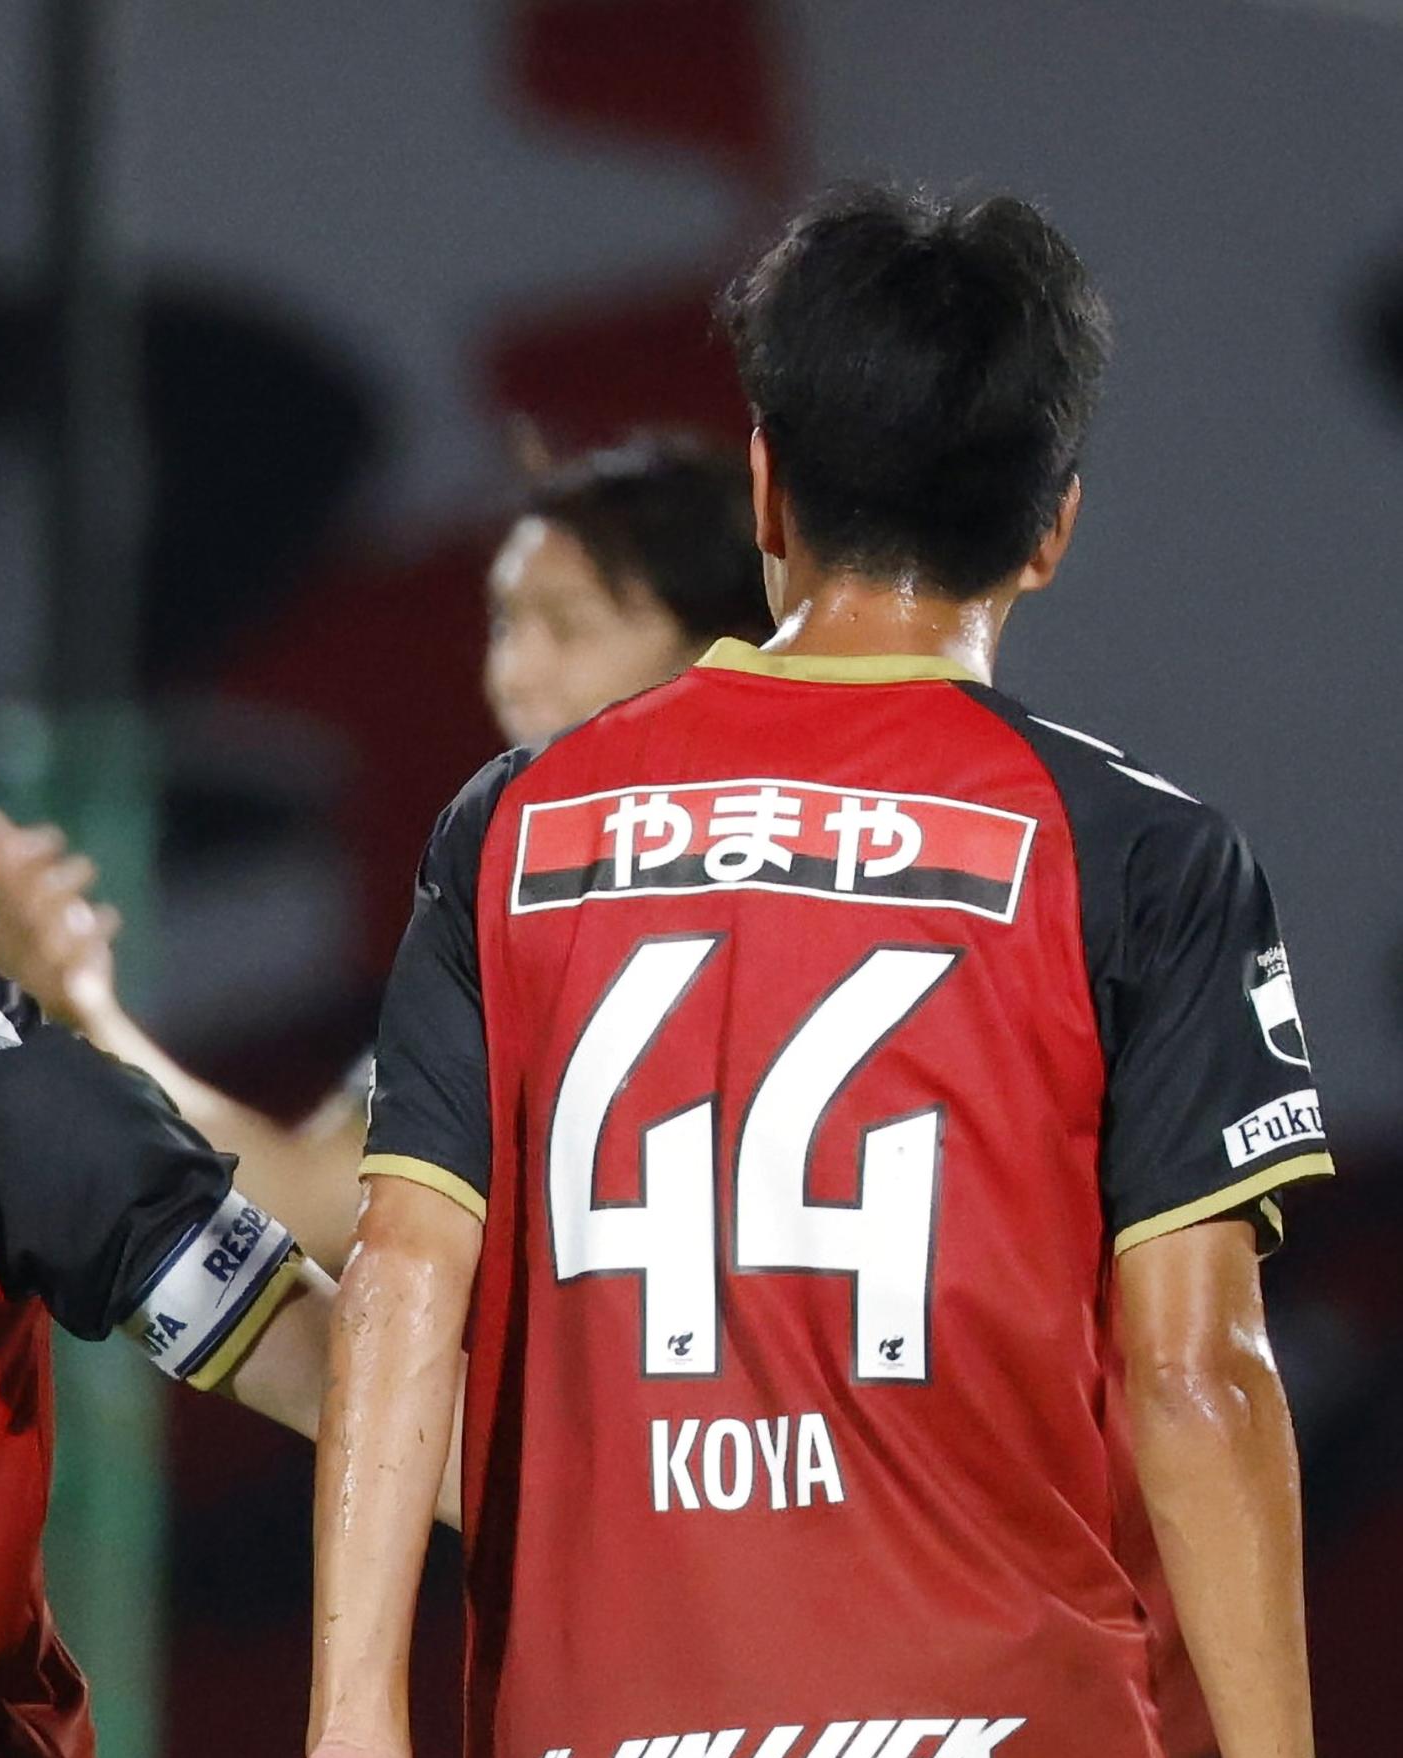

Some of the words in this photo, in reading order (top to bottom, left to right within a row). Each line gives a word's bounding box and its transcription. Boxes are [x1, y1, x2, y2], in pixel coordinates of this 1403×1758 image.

[602, 786, 923, 891] やまや
[548, 938, 958, 1380] 44
[651, 1412, 845, 1512] KOYA
